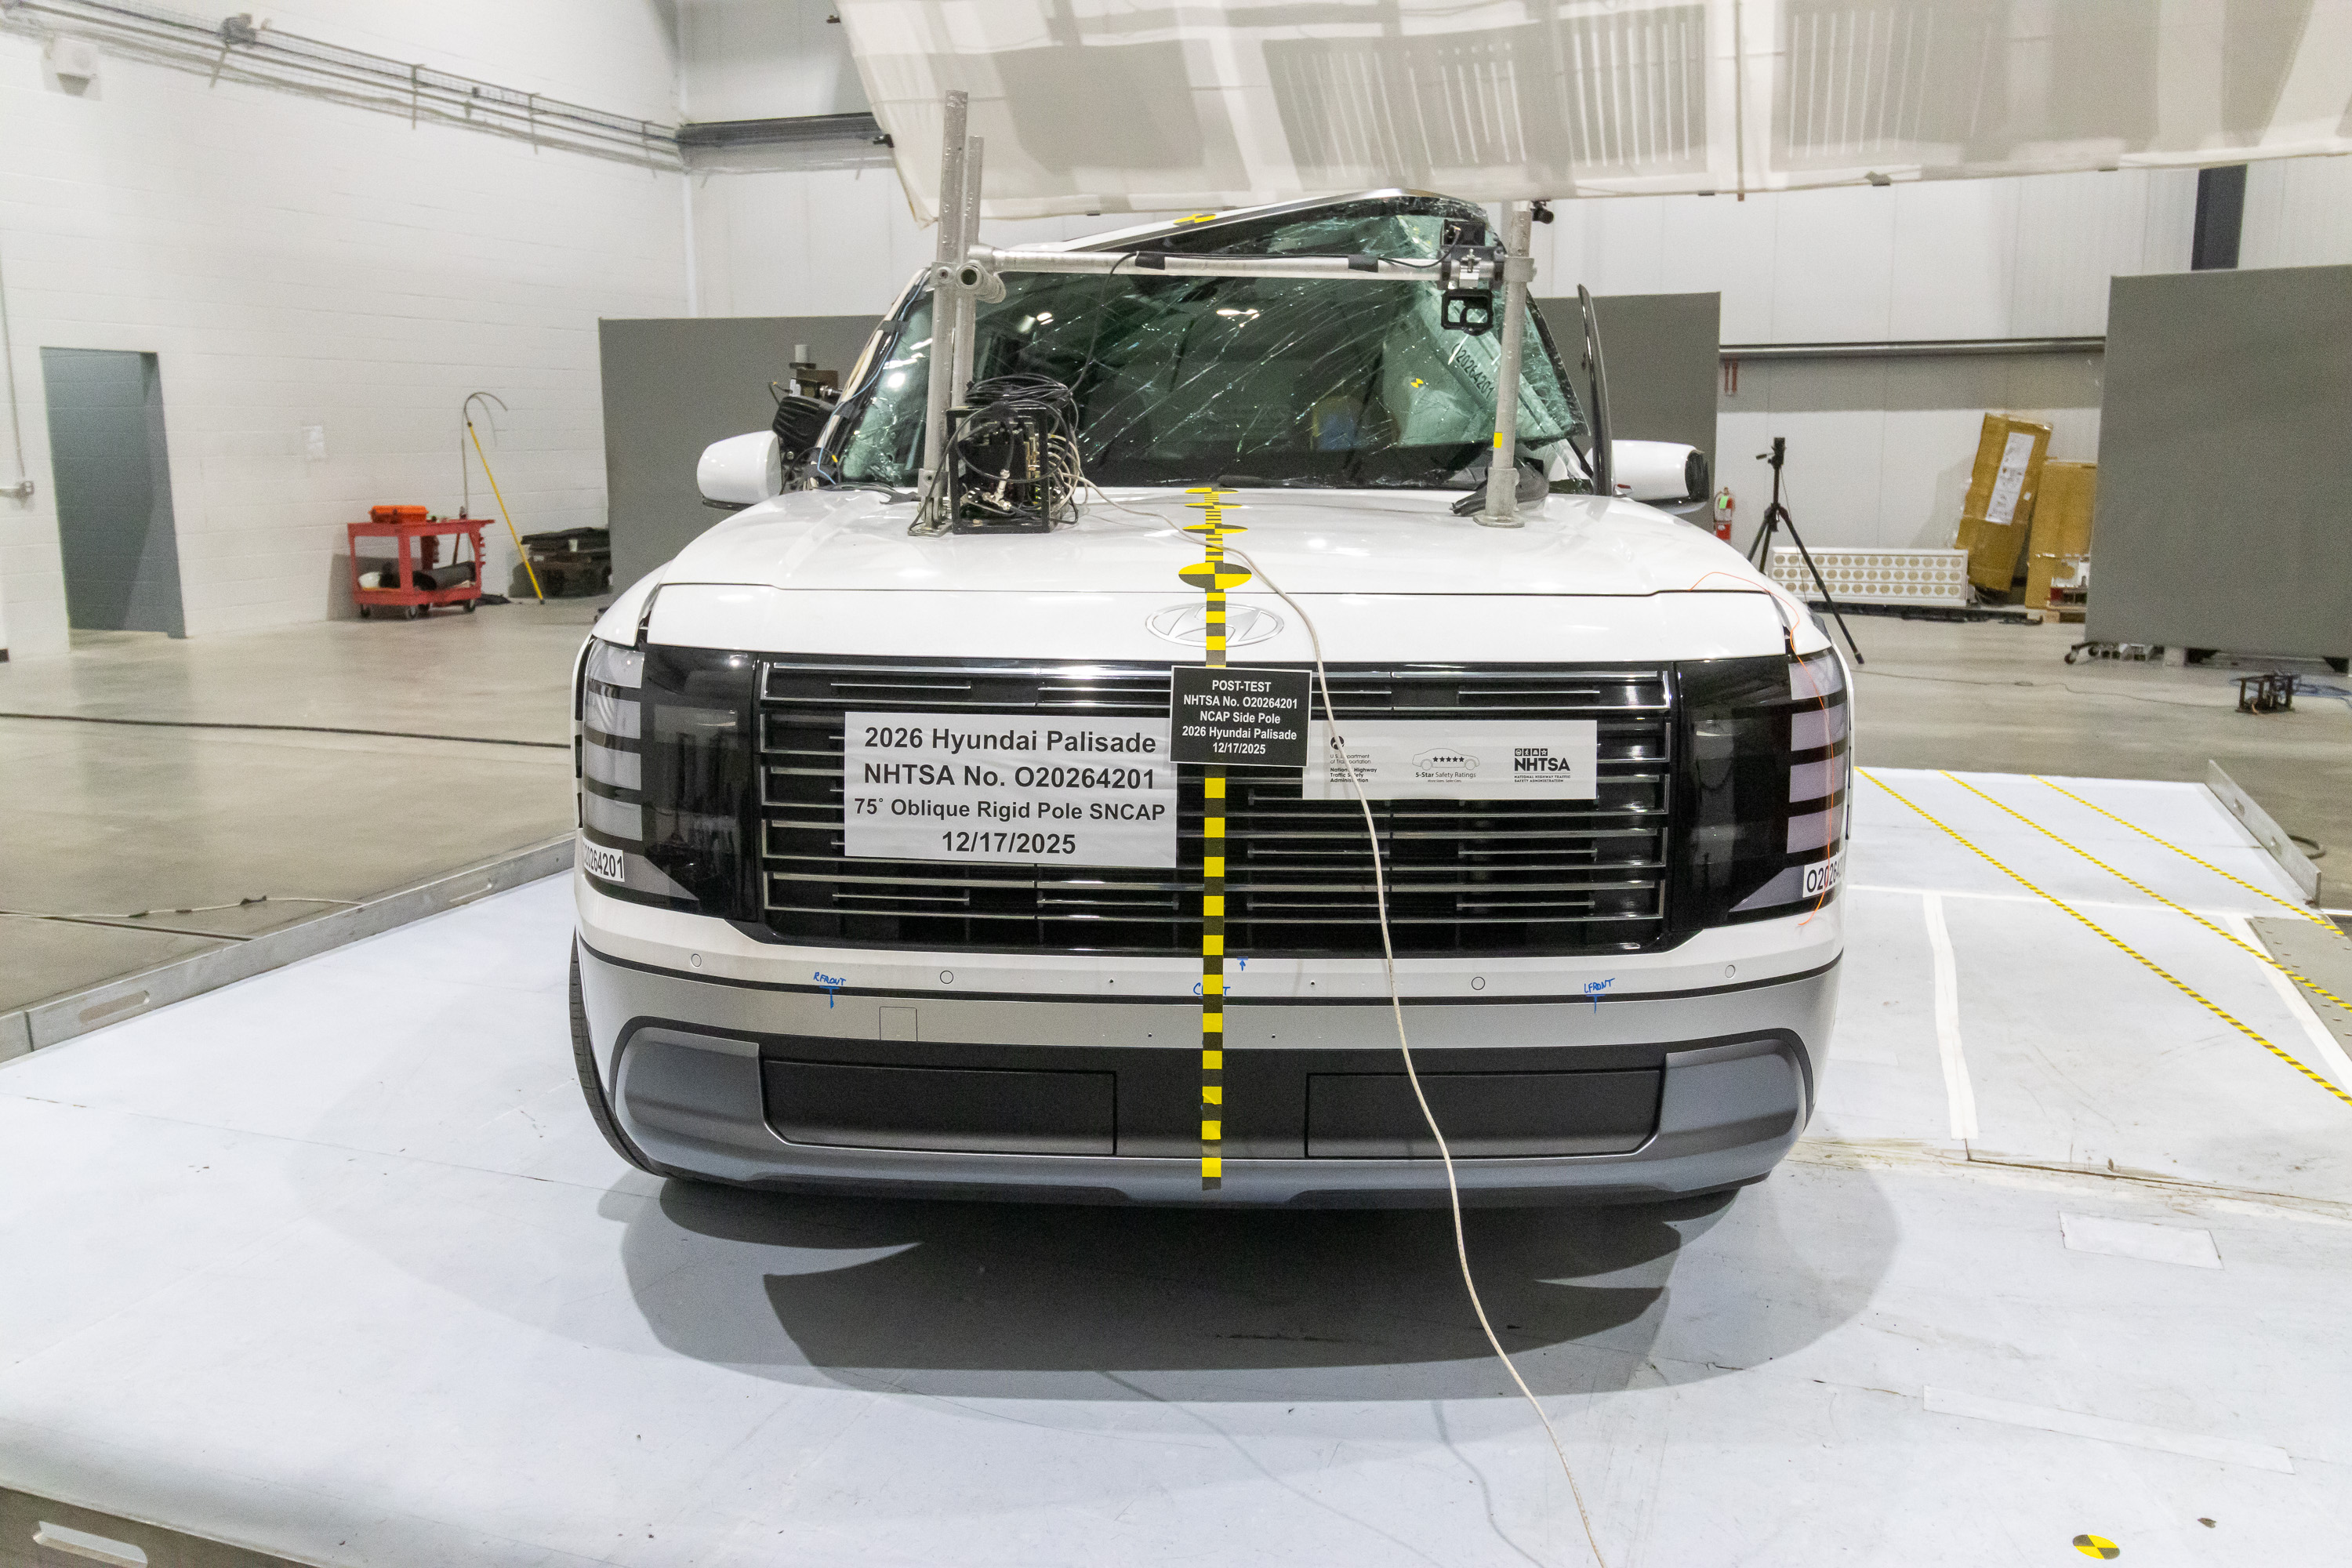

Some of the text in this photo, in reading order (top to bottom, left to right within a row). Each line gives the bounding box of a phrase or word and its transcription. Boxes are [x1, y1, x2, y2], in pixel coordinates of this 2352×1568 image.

[1211, 679, 1272, 692] POST-TEST
[1183, 694, 1298, 710] NHTSA No. O20264201
[1200, 710, 1281, 724] NCAP Side Pole
[865, 727, 1156, 754] 2026 Hyundai Palisade
[1182, 725, 1298, 741] 2026 Hyundai Palisade
[1212, 742, 1266, 755] 12/17/2025
[1514, 757, 1571, 771] NHTSA
[864, 763, 1153, 789] NHTSA No. O20264201
[891, 799, 970, 821] Oblique
[978, 800, 1030, 822] Rigid
[1037, 802, 1083, 819] Pole
[1089, 803, 1166, 821] SNCAP
[942, 831, 1076, 855] 12/17/2025
